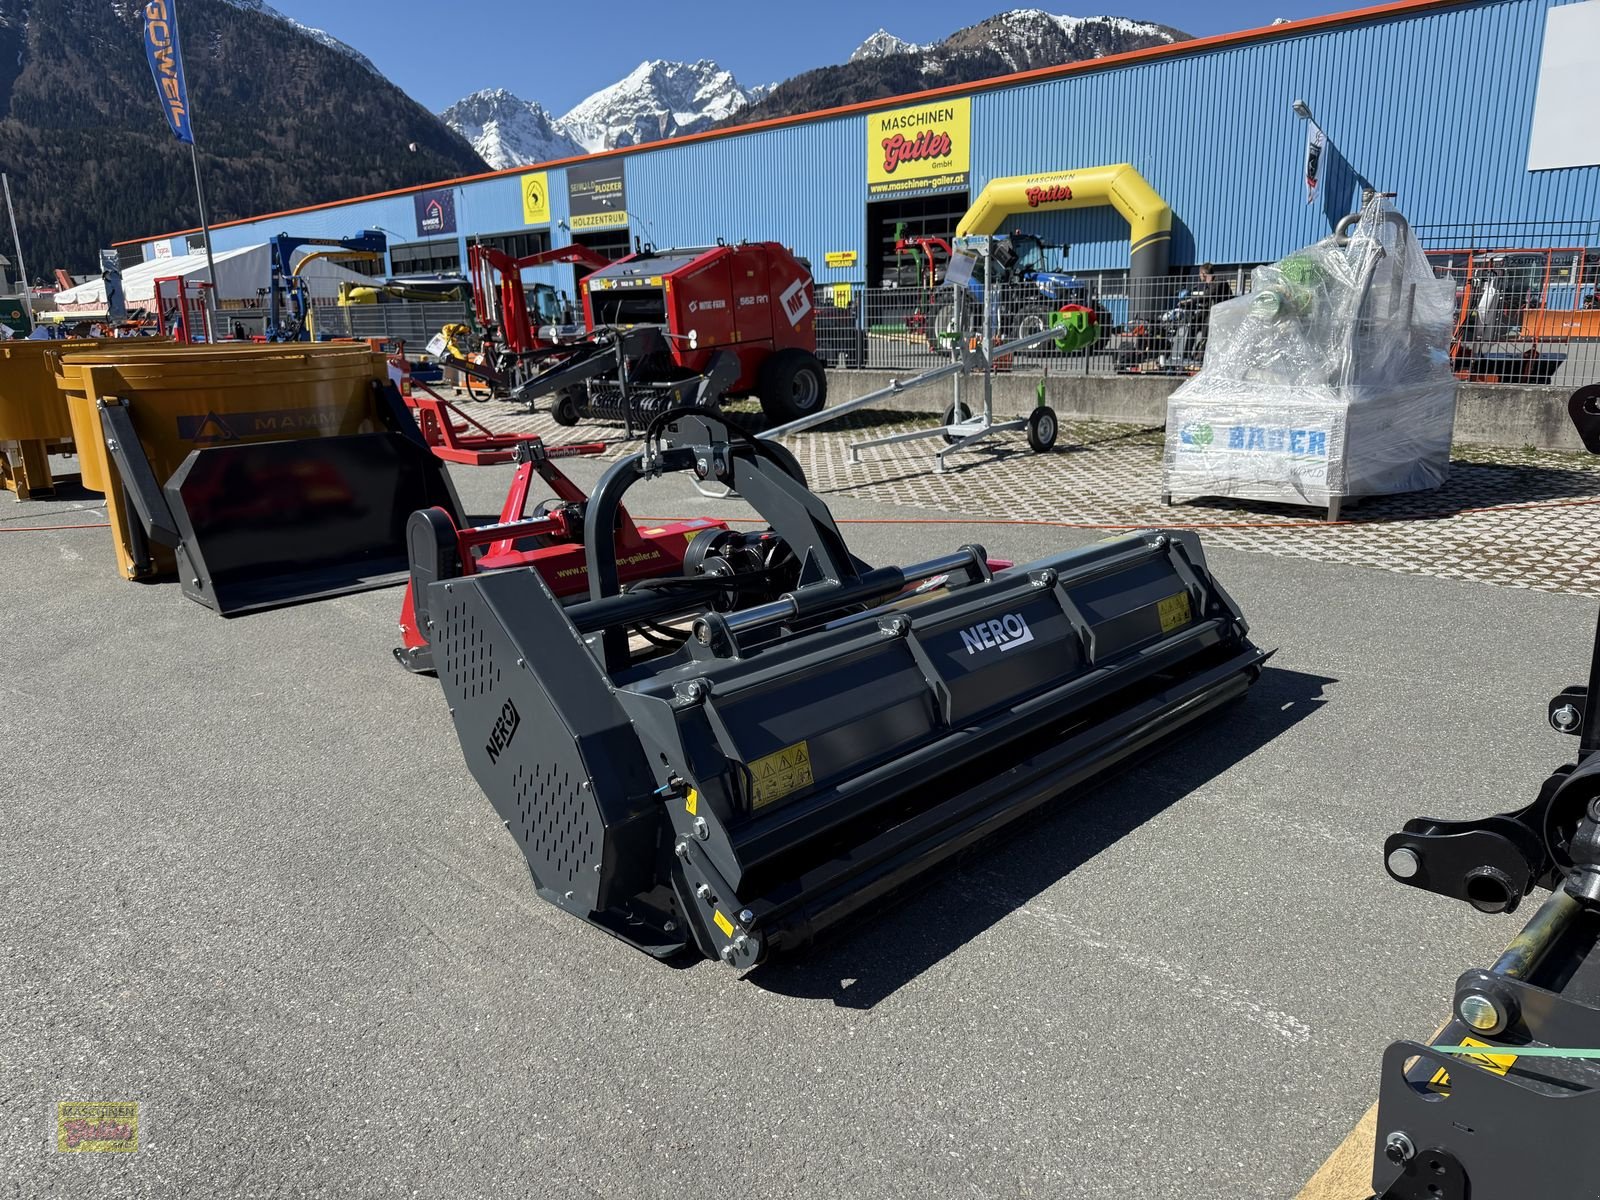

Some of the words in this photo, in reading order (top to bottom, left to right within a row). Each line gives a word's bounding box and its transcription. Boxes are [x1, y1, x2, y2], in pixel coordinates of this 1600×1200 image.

[881, 108, 953, 131] MASCHINEN
[882, 129, 952, 174] Gailer
[932, 160, 953, 169] GmbH
[871, 175, 964, 193] www.maschinen-gailer.at
[1027, 173, 1076, 185] MASCHINEN
[1025, 185, 1073, 207] Gailer
[573, 214, 625, 227] HOLZZENTRUM
[557, 550, 660, 578] www.men-gailer.at
[960, 613, 1026, 655] NERO
[486, 702, 515, 766] NERO
